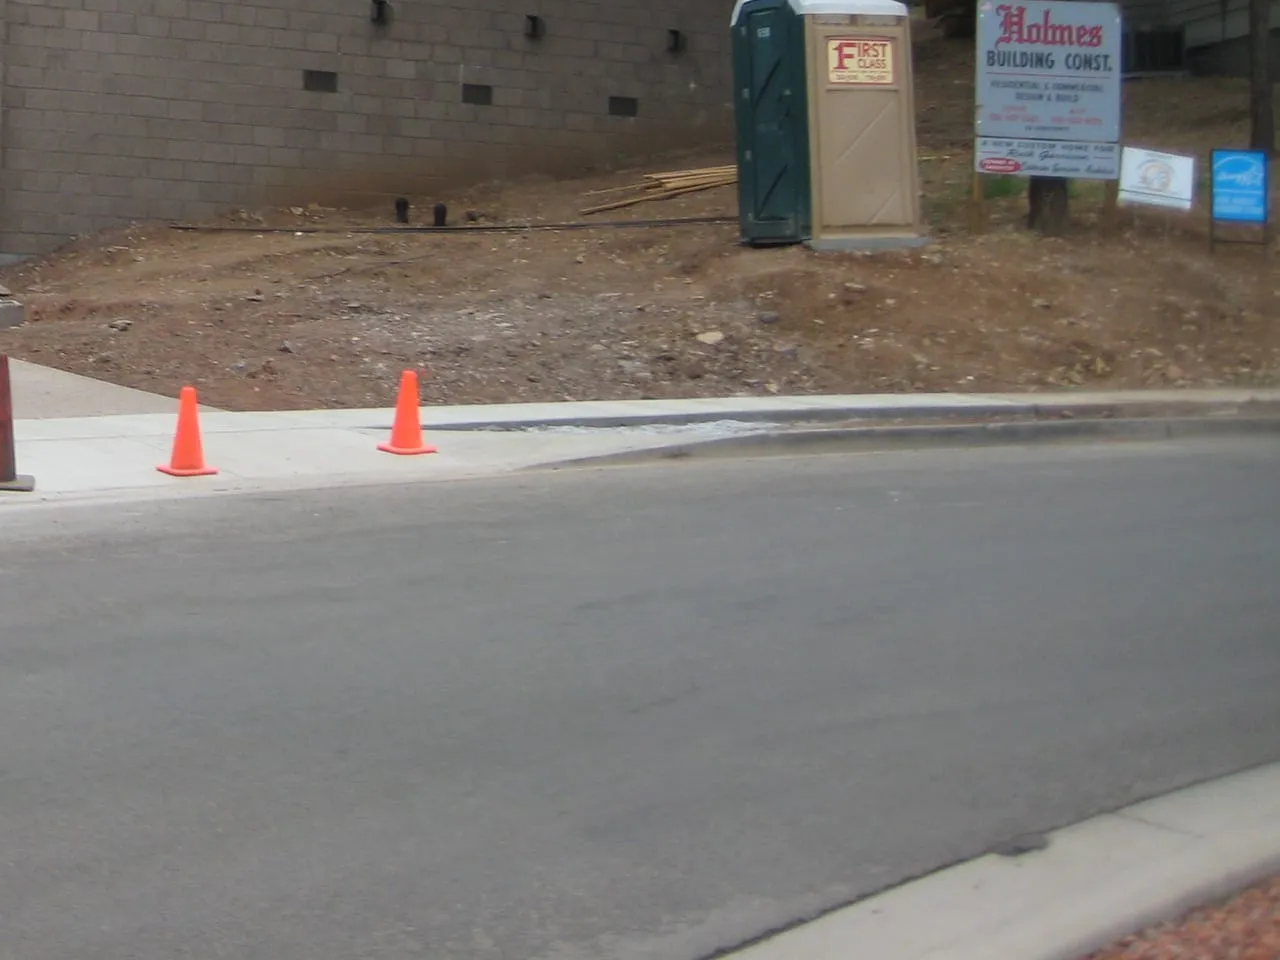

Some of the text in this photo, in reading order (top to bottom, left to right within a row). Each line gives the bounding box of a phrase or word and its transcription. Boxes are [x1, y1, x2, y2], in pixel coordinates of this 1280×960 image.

[995, 3, 1104, 49] Holmes
[832, 42, 888, 69] FIRST
[857, 58, 887, 69] CLASS
[986, 50, 1113, 72] BUILDING CONST.
